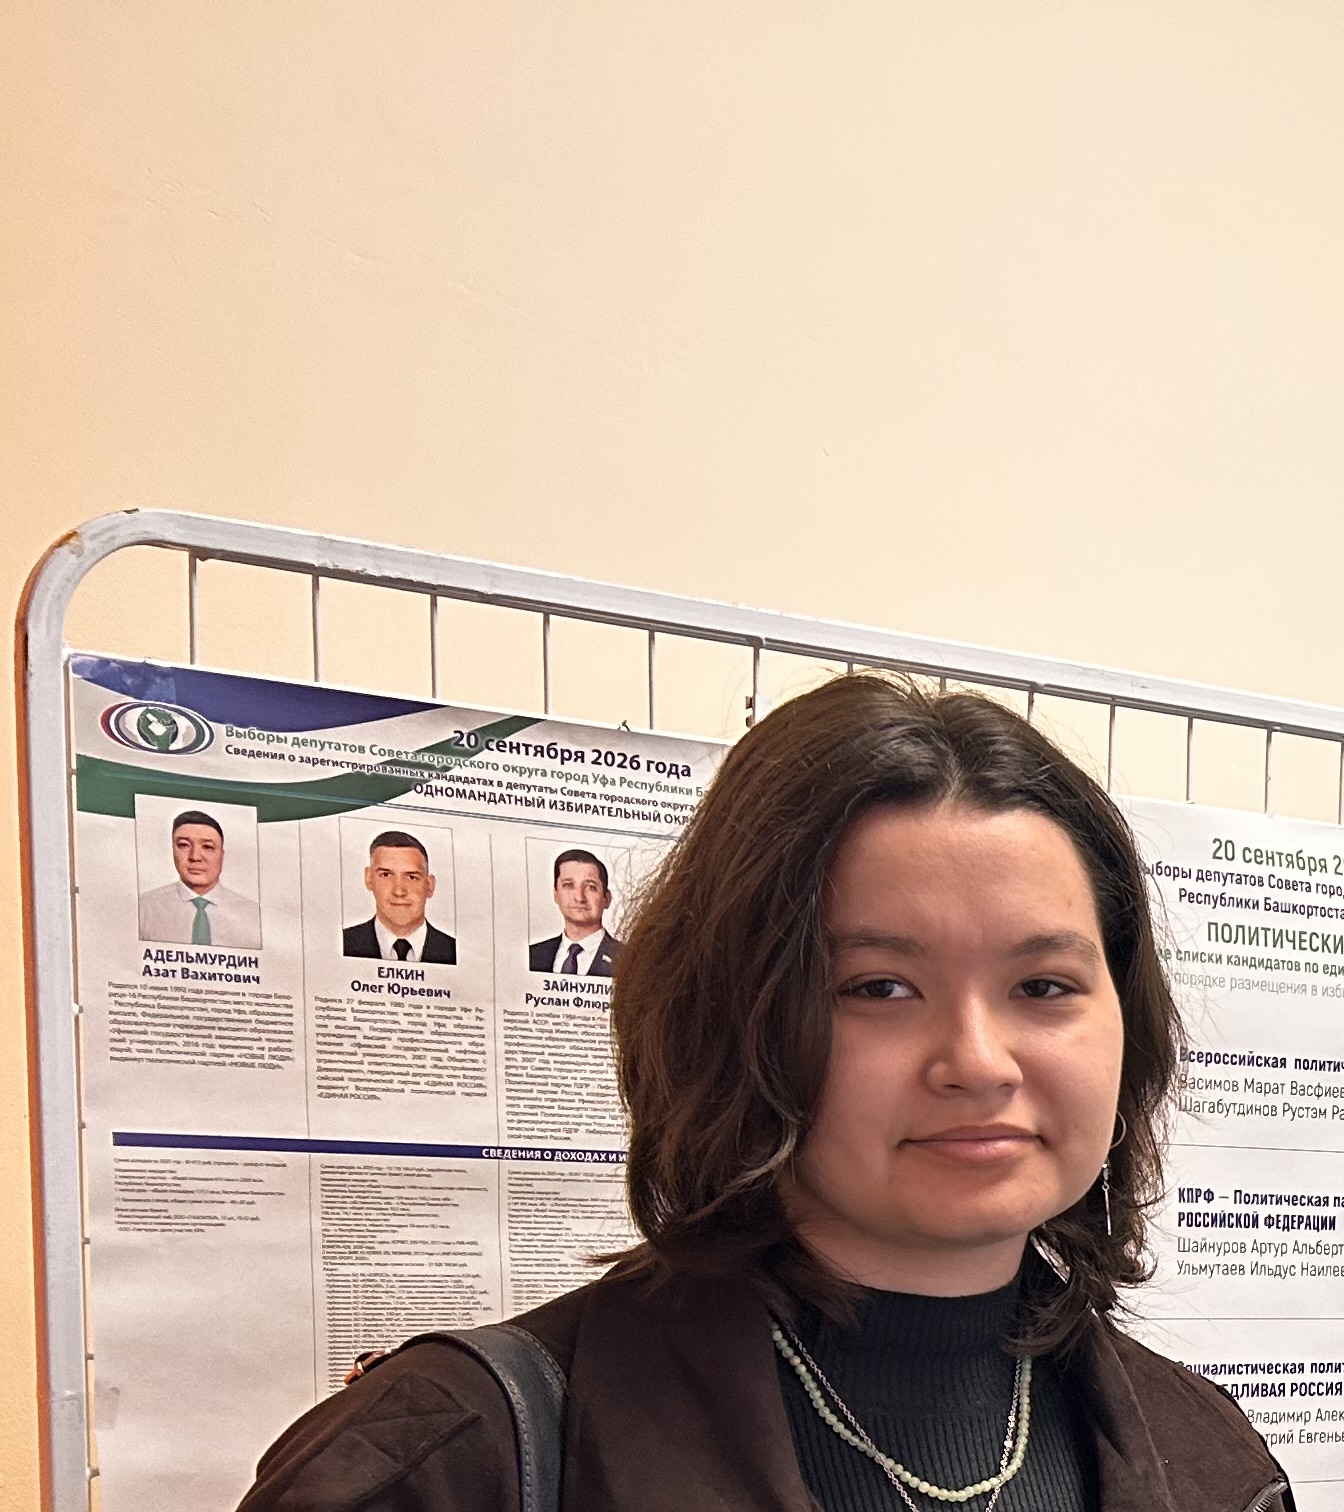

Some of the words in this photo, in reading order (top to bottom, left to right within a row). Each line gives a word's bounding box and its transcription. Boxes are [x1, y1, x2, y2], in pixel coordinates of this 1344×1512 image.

[225, 726, 287, 745] Выборы
[291, 736, 366, 754] депутатов
[369, 744, 417, 761] Совета
[421, 752, 499, 771] городского
[503, 763, 547, 779] округа
[551, 769, 589, 785] город
[592, 774, 616, 788] Уфа
[619, 776, 693, 796] Республики
[453, 729, 478, 748] 20
[485, 738, 585, 766] сентября
[591, 749, 641, 770] 2026
[646, 759, 691, 779] года
[225, 744, 285, 761] Сведения
[288, 754, 296, 762] о
[298, 754, 426, 778] зарегистрированных
[428, 771, 493, 788] кандидатах
[506, 781, 558, 797] депутаты
[560, 786, 597, 800] Совета
[599, 791, 658, 807] городского
[413, 783, 545, 808] ОДНОМАНДАТНЫЙ
[549, 800, 662, 823] ИЗБИРАТЕЛЬНЫЙ
[1212, 837, 1235, 862] 20
[1242, 846, 1328, 876] сентября
[1196, 868, 1264, 887] депутатов
[1268, 874, 1312, 893] Совета
[1179, 888, 1259, 910] Республики
[143, 949, 259, 969] АДЕЛЬМУРДИН
[1176, 949, 1222, 965] списки
[1227, 953, 1301, 972] кандидатов
[1305, 961, 1318, 974] по
[142, 965, 177, 979] Азат
[181, 967, 260, 984] Вахитович
[377, 966, 425, 982] ЕЛКИН
[351, 981, 384, 994] Олег
[387, 983, 451, 999] Юрьевич
[1230, 977, 1306, 996] размещения
[1311, 985, 1317, 996] в
[525, 993, 569, 1008] Руслан
[1179, 1046, 1287, 1069] Всероссийская
[1244, 1078, 1285, 1097] Марат
[1179, 1096, 1278, 1118] Шагабутдинов
[1282, 1102, 1327, 1121] Рустэм
[482, 1148, 541, 1161] СВЕДЕНИЯ
[543, 1150, 551, 1159] О
[554, 1151, 606, 1162] ДОХОДАХ
[608, 1152, 617, 1161] И
[1178, 1188, 1215, 1204] КПРФ
[1233, 1189, 1329, 1208] Политическая
[1178, 1210, 1259, 1229] РОССИЙСКОЙ
[1264, 1214, 1337, 1232] ФЕДЕРАЦИИ
[1178, 1237, 1247, 1256] Шайнуров
[1251, 1239, 1288, 1257] Артур
[1177, 1260, 1245, 1278] Ульмутаев
[1250, 1261, 1296, 1279] Ильдус
[1176, 1361, 1305, 1375] оциалистическая
[1290, 1381, 1343, 1397] РОССИЯ
[1247, 1409, 1311, 1426] Владимир
